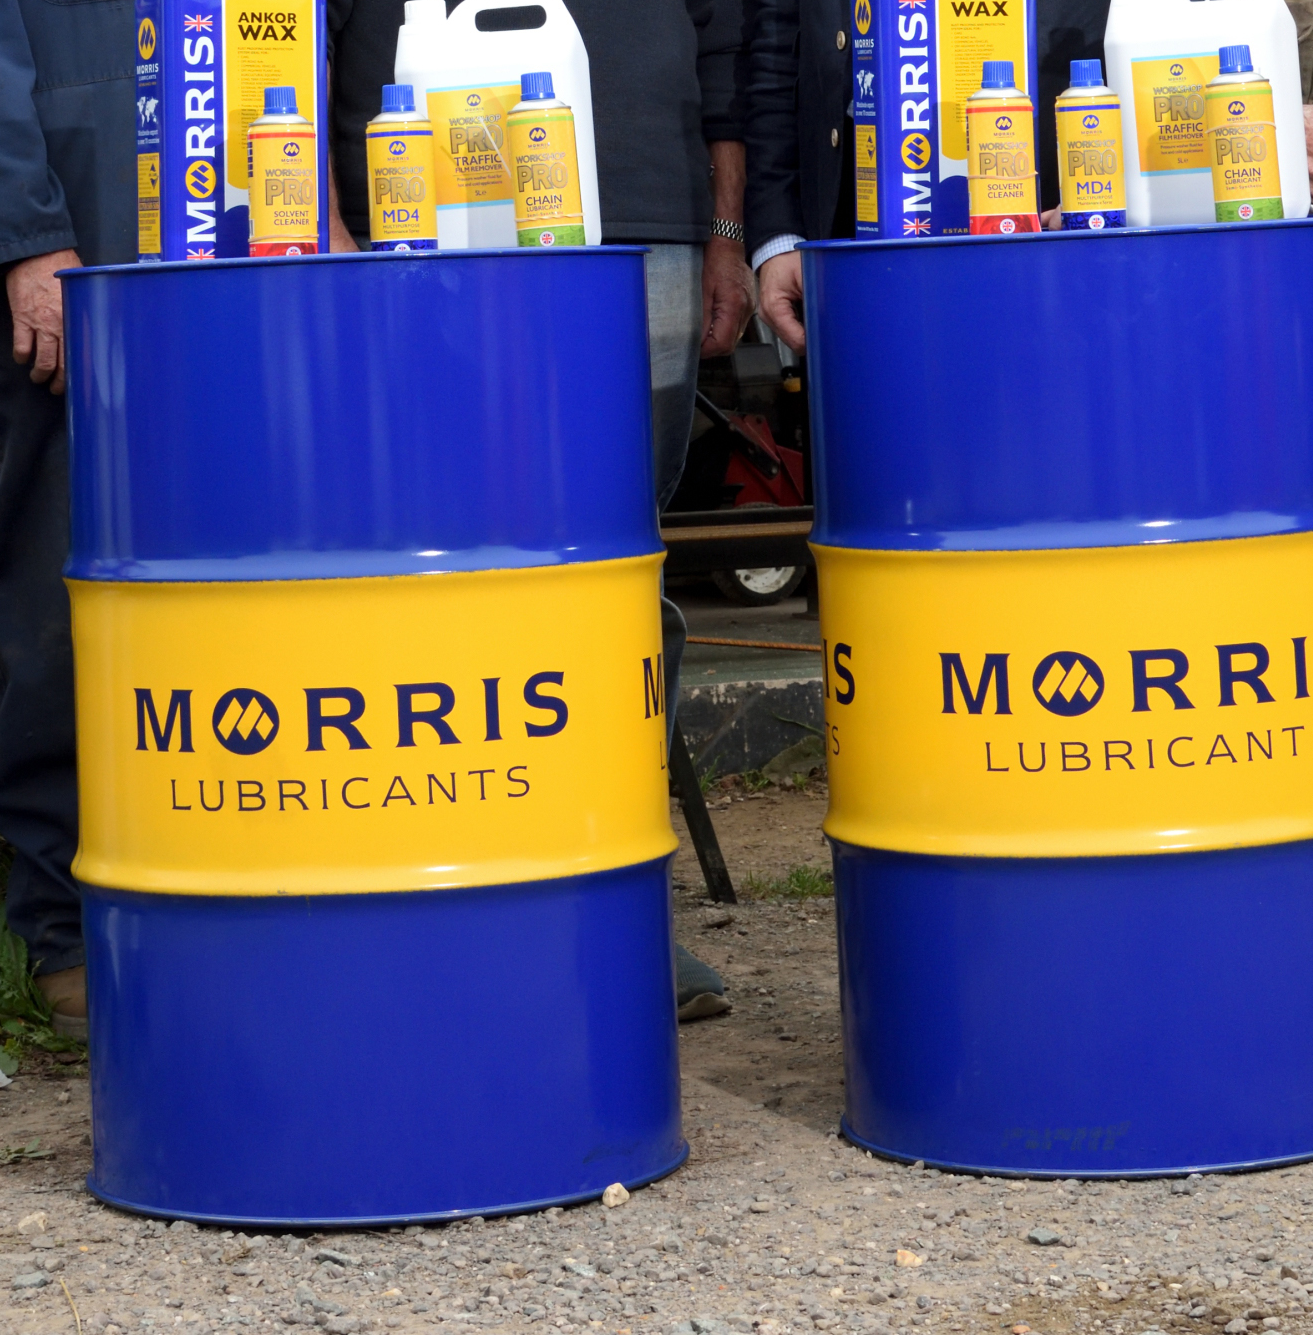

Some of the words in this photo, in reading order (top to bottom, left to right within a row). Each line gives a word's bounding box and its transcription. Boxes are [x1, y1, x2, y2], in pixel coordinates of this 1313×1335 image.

[951, 1, 1008, 17] WAX
[238, 12, 297, 24] ANKOR
[238, 25, 297, 41] WAX
[854, 39, 874, 48] MORRIS
[136, 63, 159, 75] MORRIS
[1153, 84, 1202, 95] WORKSHOP
[898, 12, 932, 214] MORRIS
[1154, 93, 1204, 122] PRO
[449, 114, 501, 126] WORKSHOP
[1158, 122, 1203, 134] TRAFFIC
[1215, 125, 1264, 137] WORKSHOP
[183, 35, 216, 243] MORRIS
[450, 124, 503, 154] PRO
[1067, 139, 1116, 149] WORKSHOP
[979, 142, 1028, 151] WORKSHOP
[1216, 135, 1267, 165] PRO
[454, 153, 502, 166] TRAFFIC
[516, 152, 566, 164] WORKSHOP
[1068, 148, 1117, 177] PRO
[374, 166, 424, 176] WORKSHOP
[979, 151, 1029, 179] PRO
[265, 169, 313, 177] WORKSHOP
[517, 161, 568, 193] PRO
[1225, 167, 1261, 179] CHAIN
[988, 183, 1023, 191] SOLVENT
[1225, 177, 1262, 185] LUBRICANT
[265, 178, 314, 206] PRO
[375, 176, 426, 205] PRO
[1076, 180, 1112, 195] MD4
[526, 195, 562, 206] CHAIN
[988, 191, 1024, 199] CLEANER
[526, 204, 562, 212] LUBRICANT
[383, 208, 419, 223] MD4
[133, 671, 569, 755] MORRIS
[170, 765, 530, 812] LUBRICANTS
